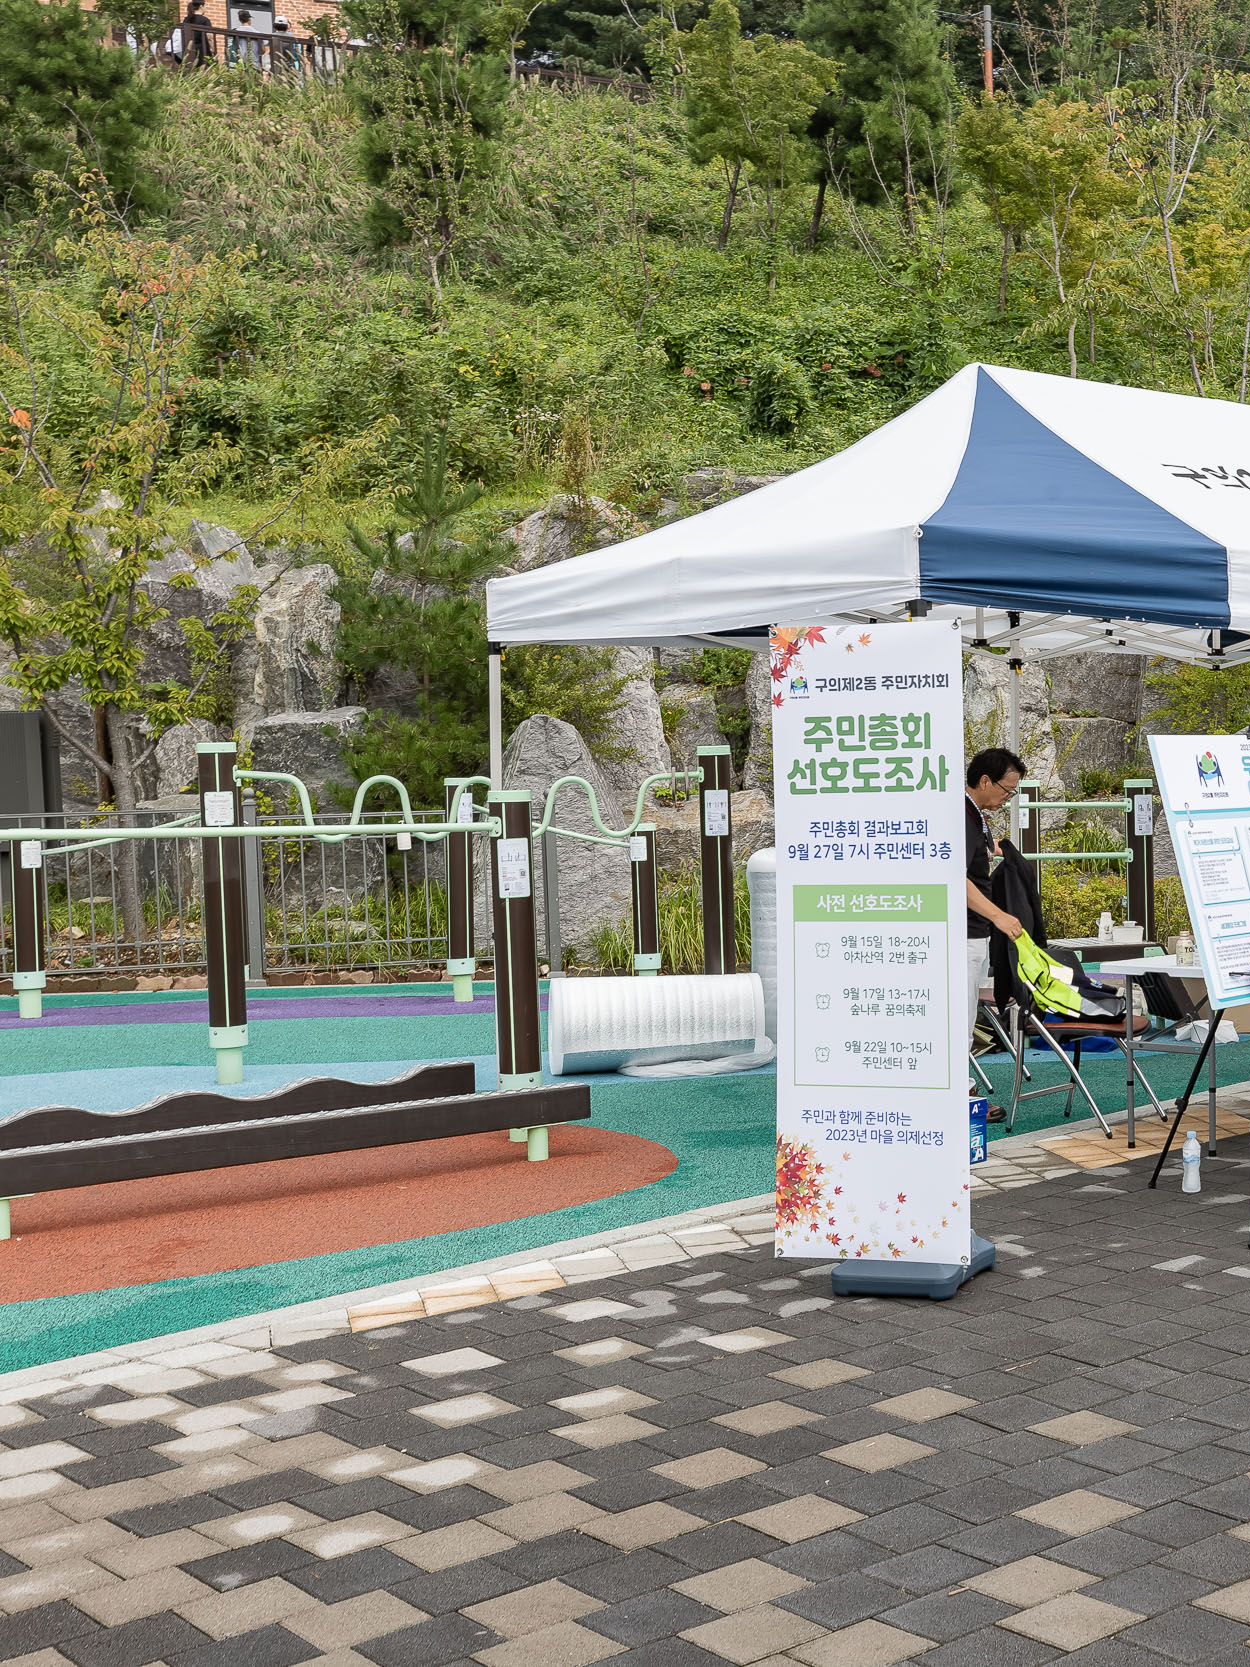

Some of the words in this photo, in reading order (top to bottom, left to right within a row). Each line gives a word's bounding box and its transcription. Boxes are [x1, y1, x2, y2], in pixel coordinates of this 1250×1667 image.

[815, 676, 877, 692] 구의제2동
[881, 673, 949, 690] 주민자치회
[804, 712, 931, 752] 주민총회
[787, 754, 949, 795] 선호도조사
[809, 820, 860, 838] 주민총회
[864, 819, 928, 837] 결과보고회
[788, 843, 809, 860] 9월
[813, 843, 844, 860] 27일
[848, 842, 870, 860] 7시
[873, 842, 925, 859] 주민센터
[929, 841, 952, 859] 3층
[816, 894, 845, 913] 사전
[849, 893, 923, 913] 선호도조사
[841, 935, 857, 948] 9월
[860, 935, 883, 948] 15일
[888, 935, 930, 948] 18~20시
[843, 951, 884, 964] 아차산역
[888, 951, 905, 963] 2번
[907, 951, 928, 964] 출구
[843, 987, 859, 1001] 9월
[863, 987, 885, 1000] 17일
[888, 988, 930, 1001] 13~17시
[850, 1003, 880, 1016] 숲나루
[885, 1003, 926, 1016] 꿈의축제
[844, 1040, 861, 1053] 9월
[864, 1040, 887, 1053] 22일
[890, 1041, 932, 1055] 10~15시
[862, 1056, 903, 1070] 주민센터
[907, 1057, 918, 1070] 앞
[801, 1109, 836, 1124] 주민과
[839, 1110, 862, 1125] 함께
[864, 1111, 912, 1127] 준비하는
[825, 1128, 867, 1143] 2023년
[870, 1129, 894, 1145] 마을
[897, 1130, 944, 1146] 의제선정
